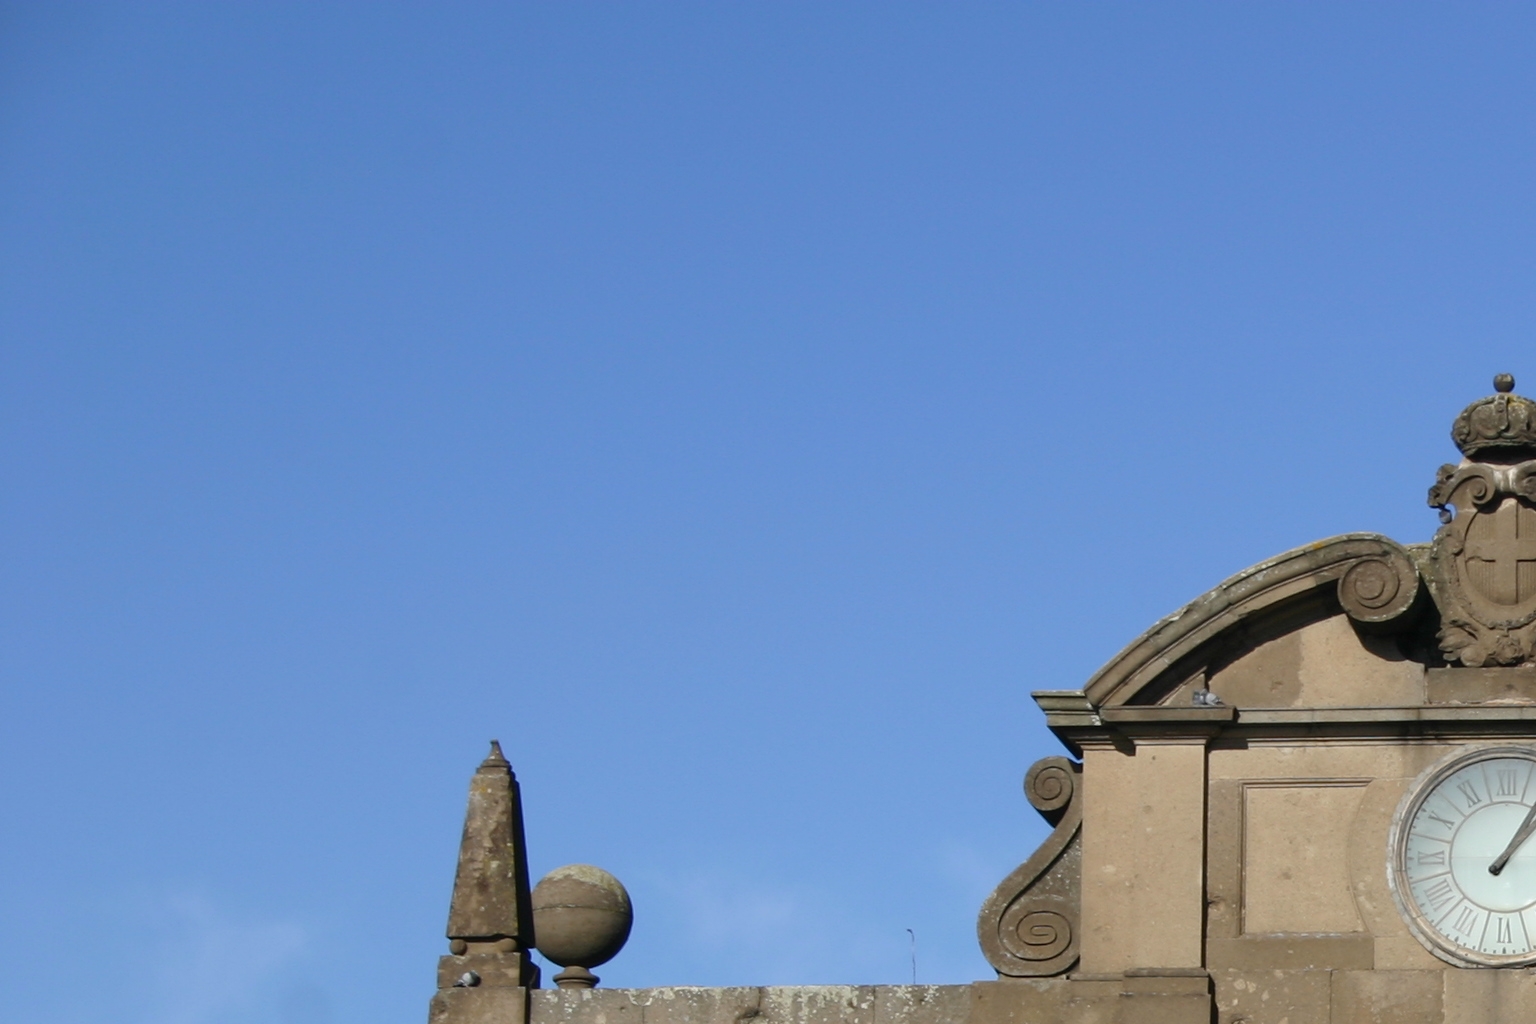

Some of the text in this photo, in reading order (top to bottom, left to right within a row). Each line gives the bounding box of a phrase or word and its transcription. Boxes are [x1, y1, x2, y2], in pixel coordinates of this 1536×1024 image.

[1457, 779, 1482, 808] XI
[1496, 769, 1517, 796] XII
[1428, 810, 1455, 830] X
[1417, 850, 1444, 866] IX
[1424, 878, 1456, 912] VIII
[1452, 906, 1480, 937] VII
[1497, 917, 1512, 943] VI
